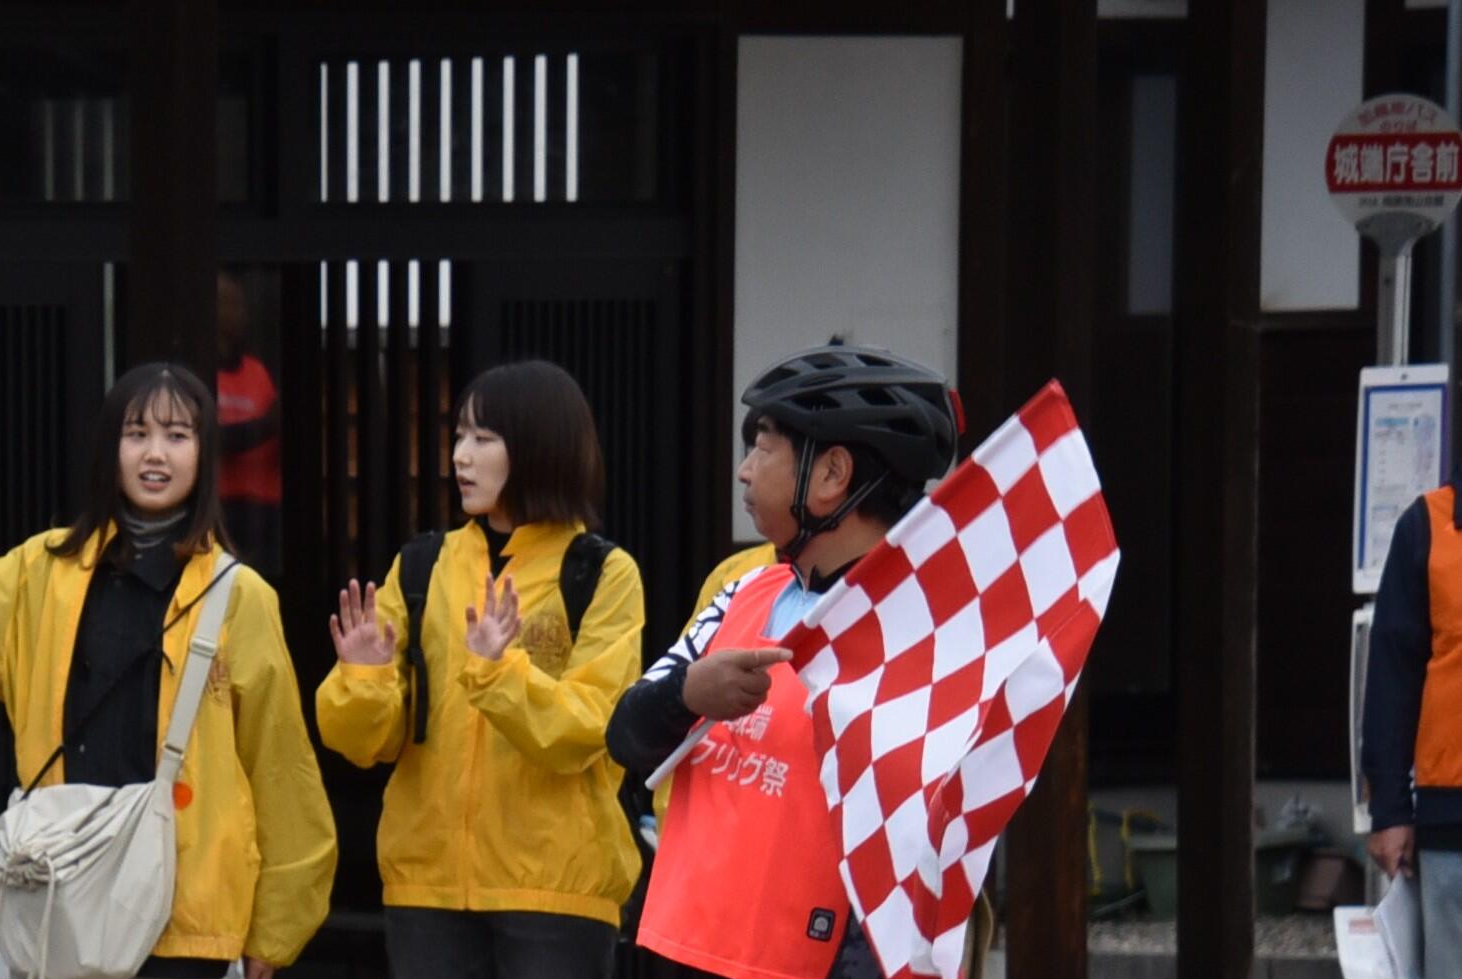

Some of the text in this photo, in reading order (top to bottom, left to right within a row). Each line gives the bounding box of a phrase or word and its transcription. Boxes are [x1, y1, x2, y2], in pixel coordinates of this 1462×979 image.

[1333, 142, 1460, 185] 城端庁舎前
